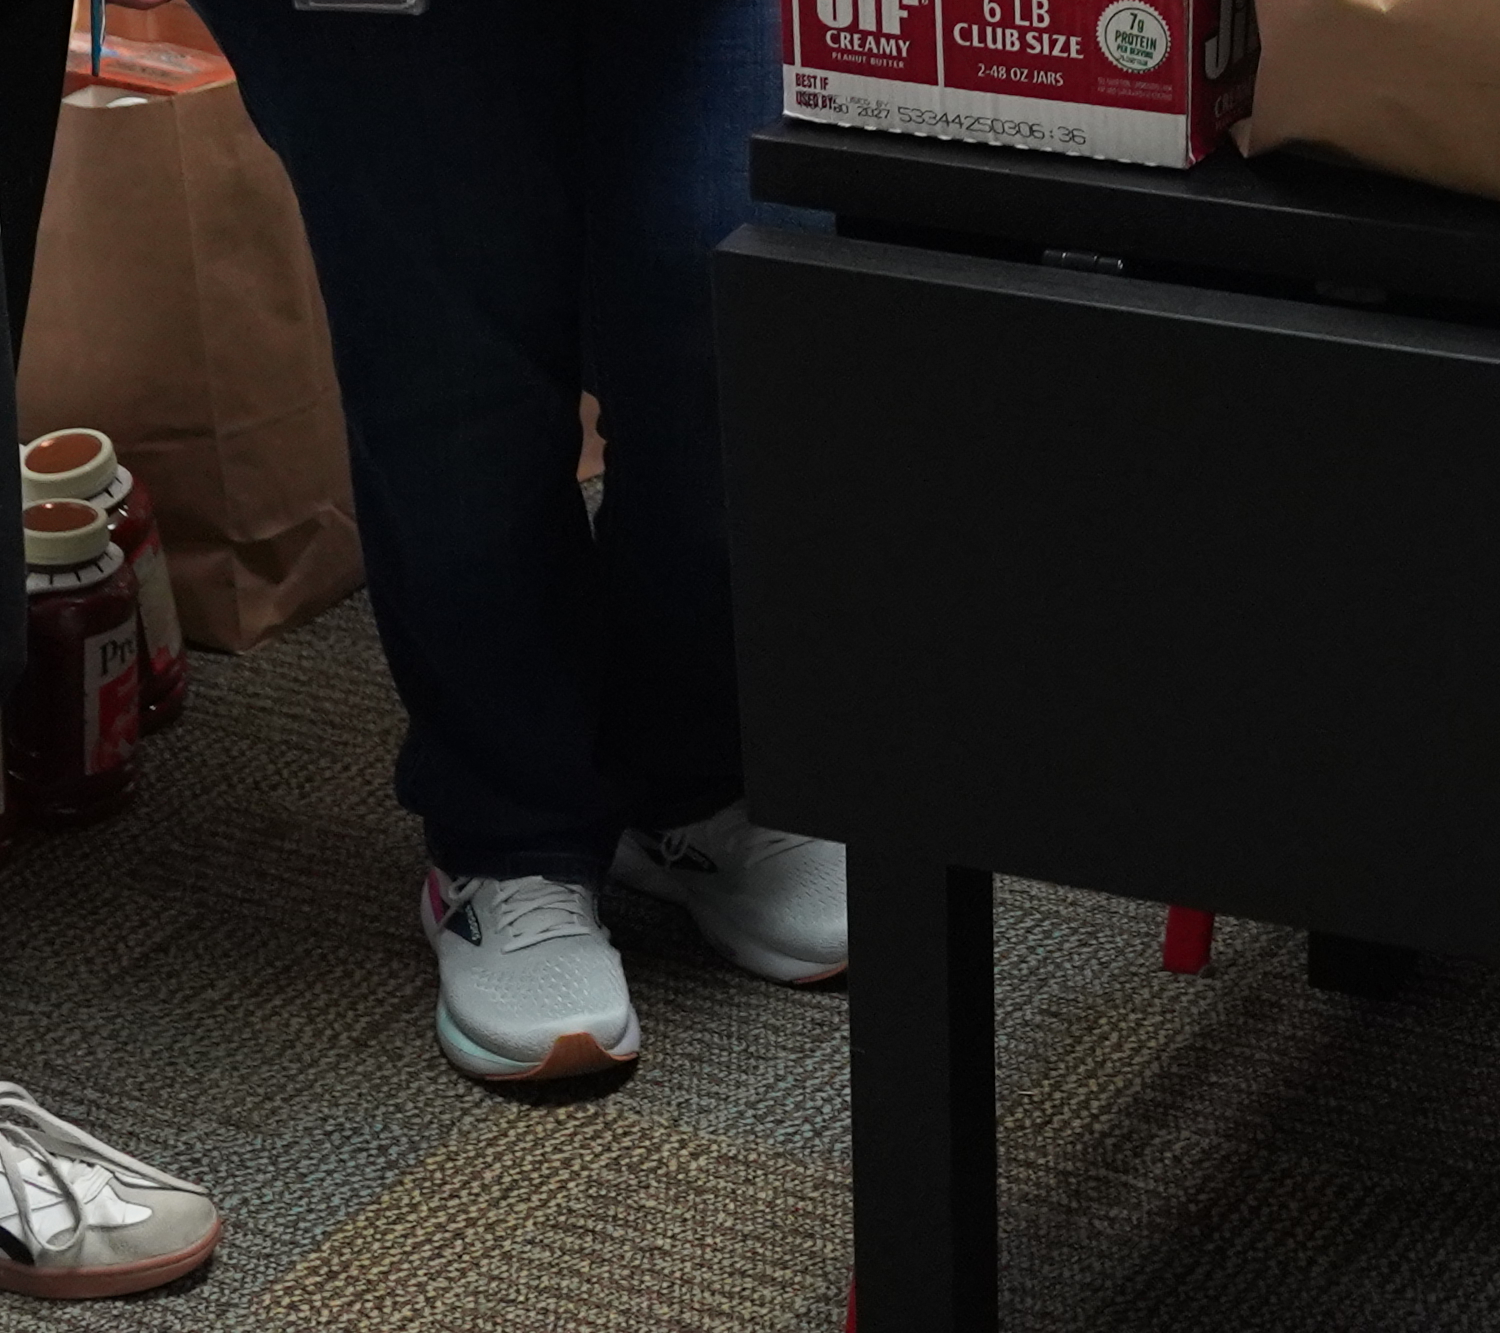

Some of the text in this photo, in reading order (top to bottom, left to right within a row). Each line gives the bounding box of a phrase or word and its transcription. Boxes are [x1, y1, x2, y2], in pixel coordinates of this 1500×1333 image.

[825, 29, 910, 58] CREAMY
[953, 22, 1084, 60] CLUB SIZE
[1113, 30, 1158, 53] PROTEIN
[978, 63, 1064, 87] 2-48 OZ JARS
